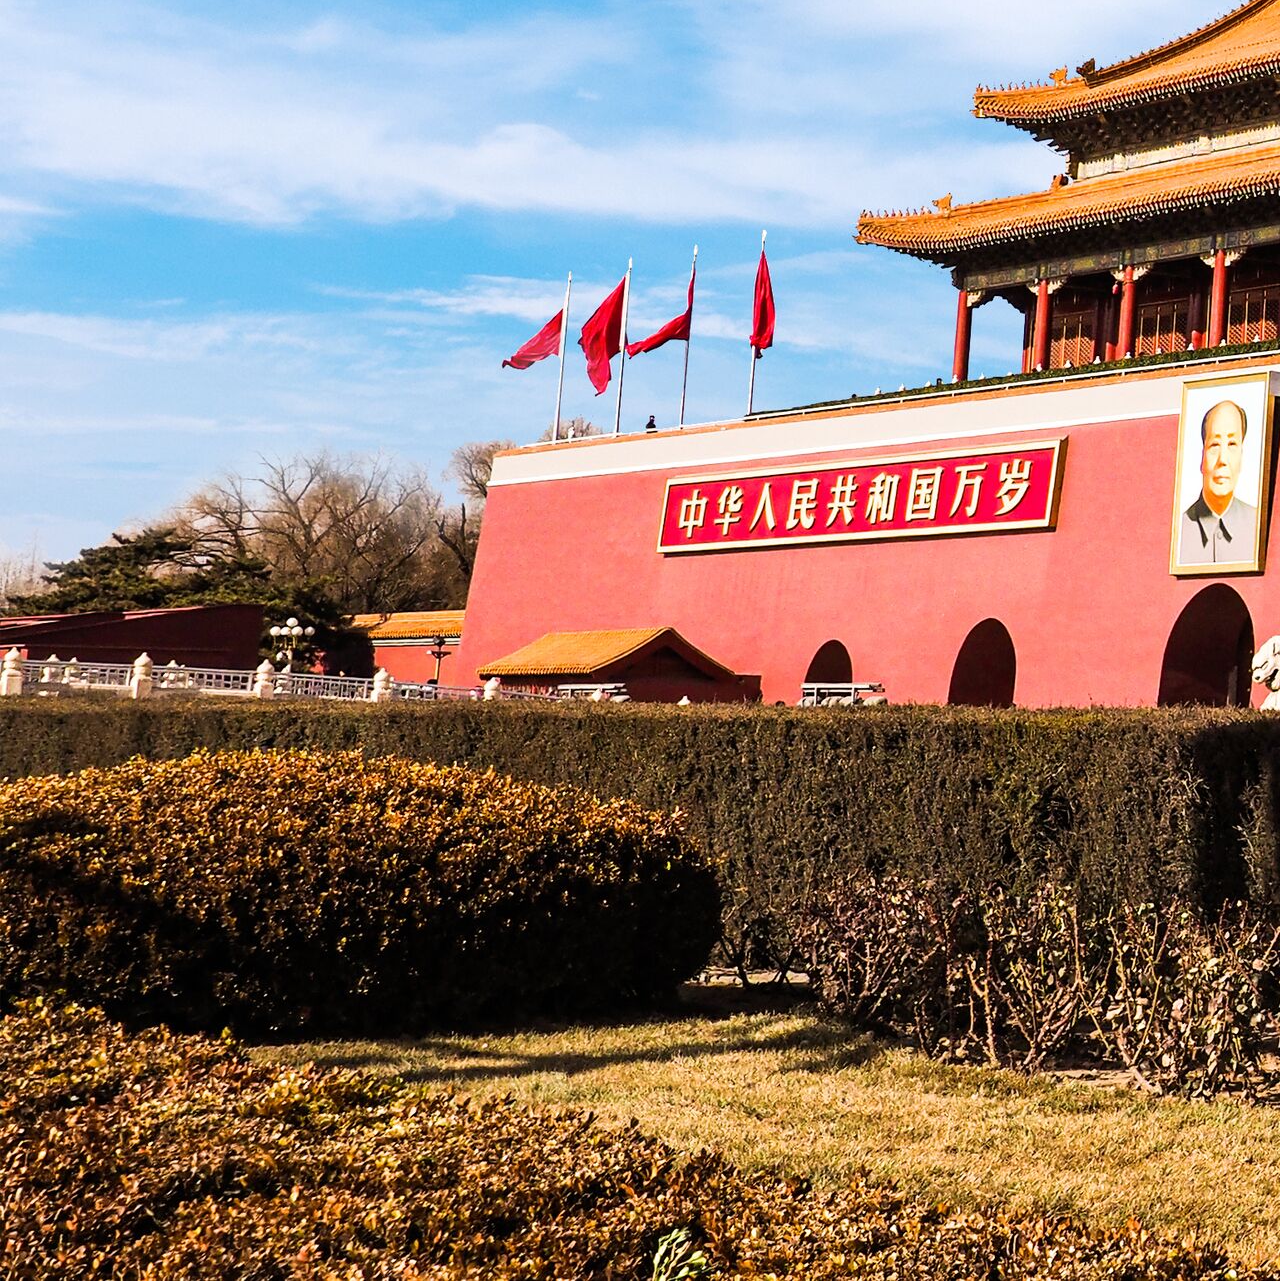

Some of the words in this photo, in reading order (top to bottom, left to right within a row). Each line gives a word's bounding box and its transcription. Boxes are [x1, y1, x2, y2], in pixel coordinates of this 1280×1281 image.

[678, 458, 1033, 539] 中华人民共和国万岁
